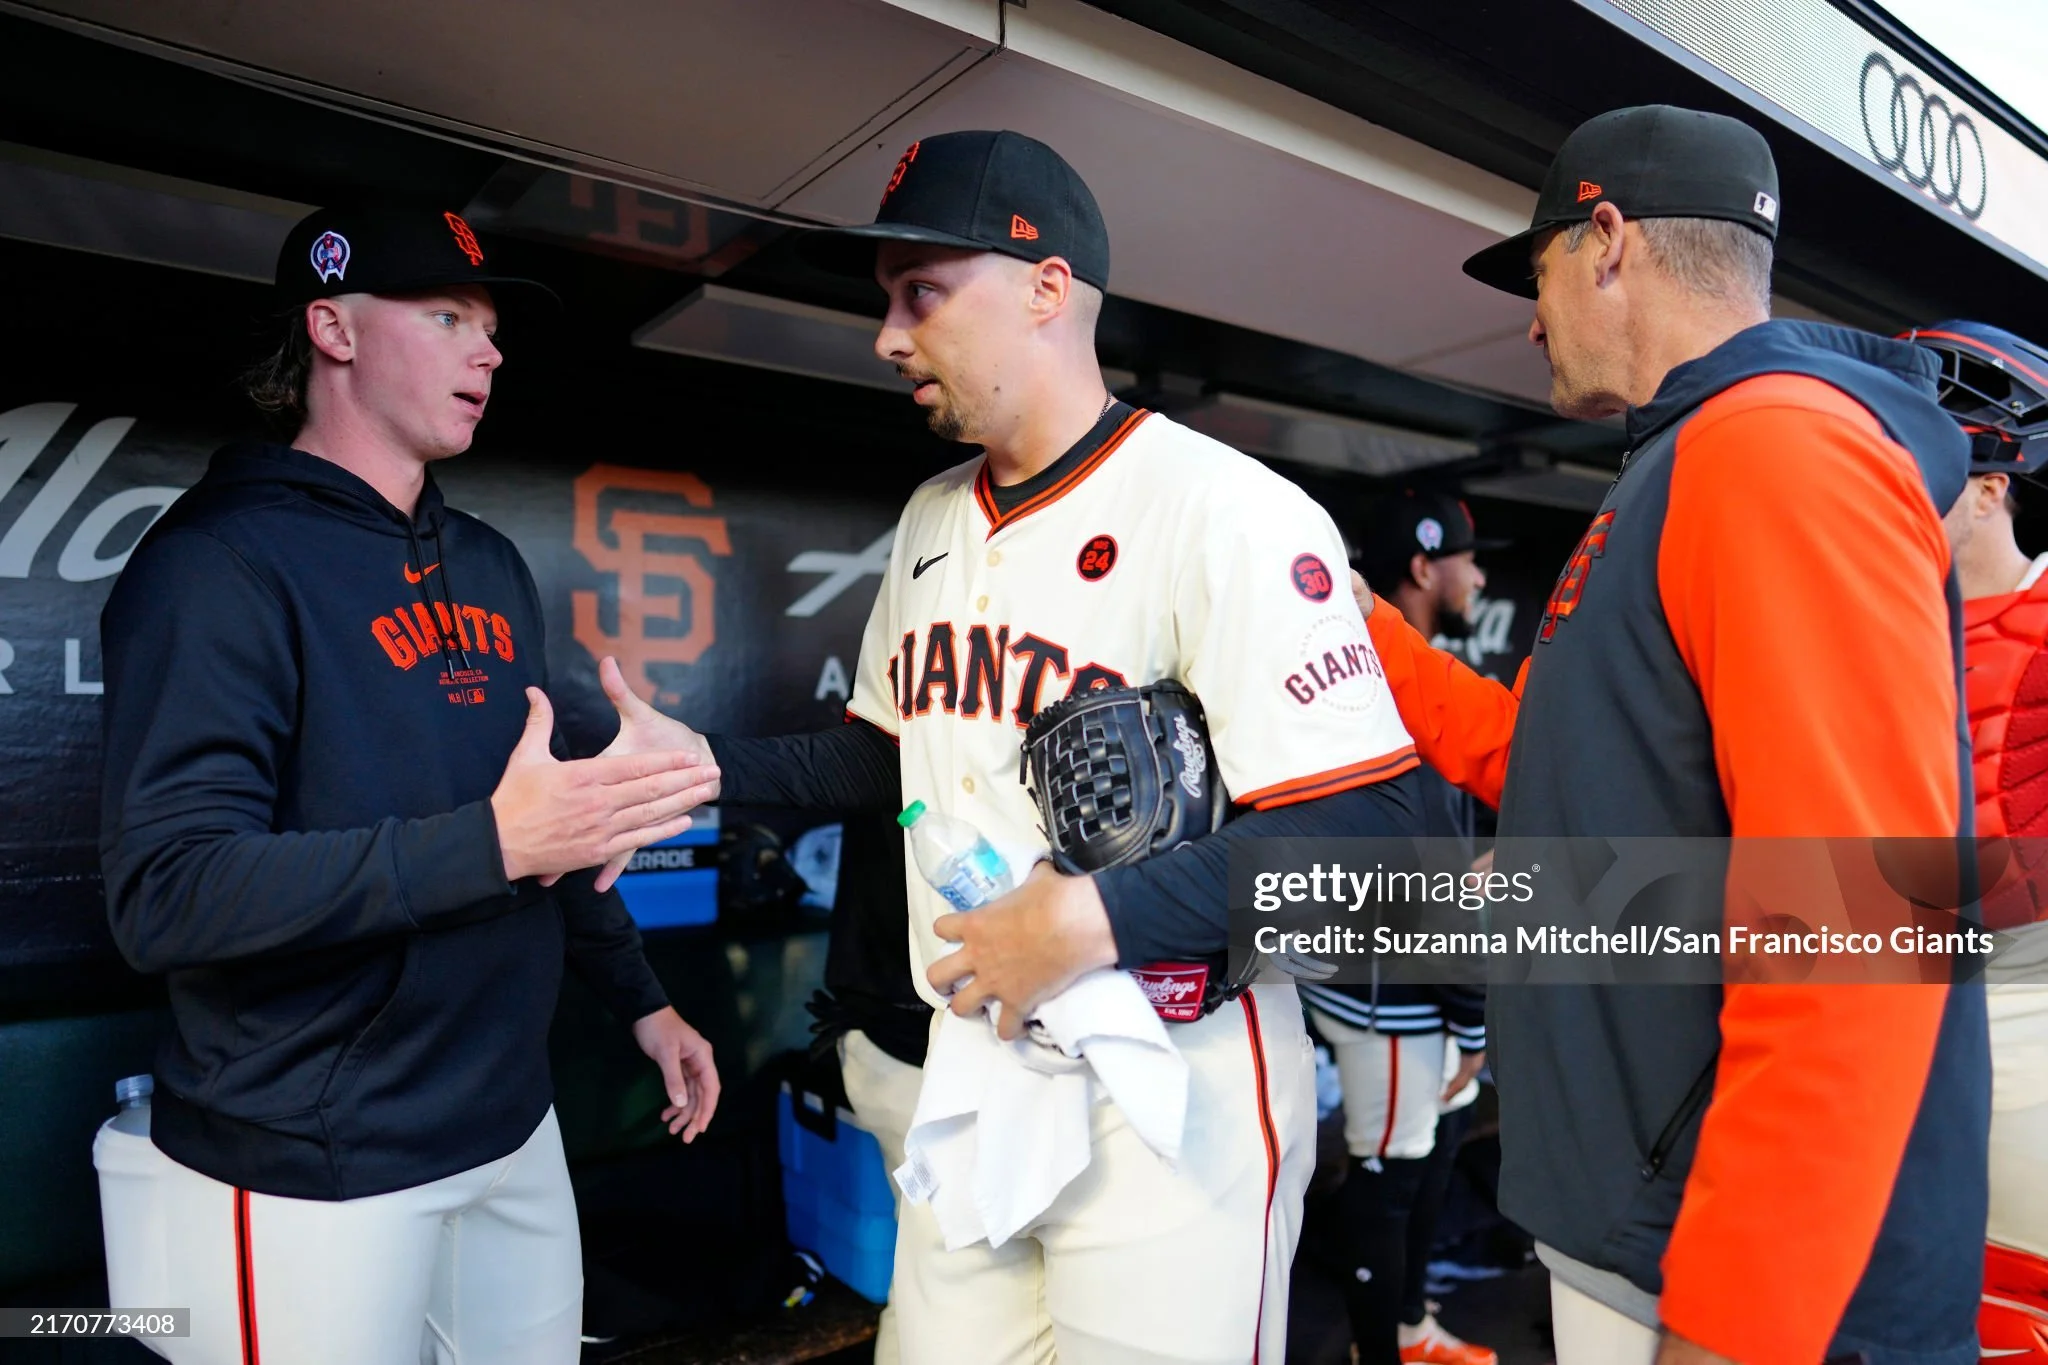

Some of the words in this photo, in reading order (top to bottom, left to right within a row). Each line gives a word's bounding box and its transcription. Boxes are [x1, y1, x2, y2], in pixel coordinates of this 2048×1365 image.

[1082, 550, 1110, 571] 24
[1300, 571, 1330, 596] 30
[371, 601, 515, 671] GIANTS
[887, 621, 1130, 729] IANT
[1285, 643, 1383, 705] GIANTS
